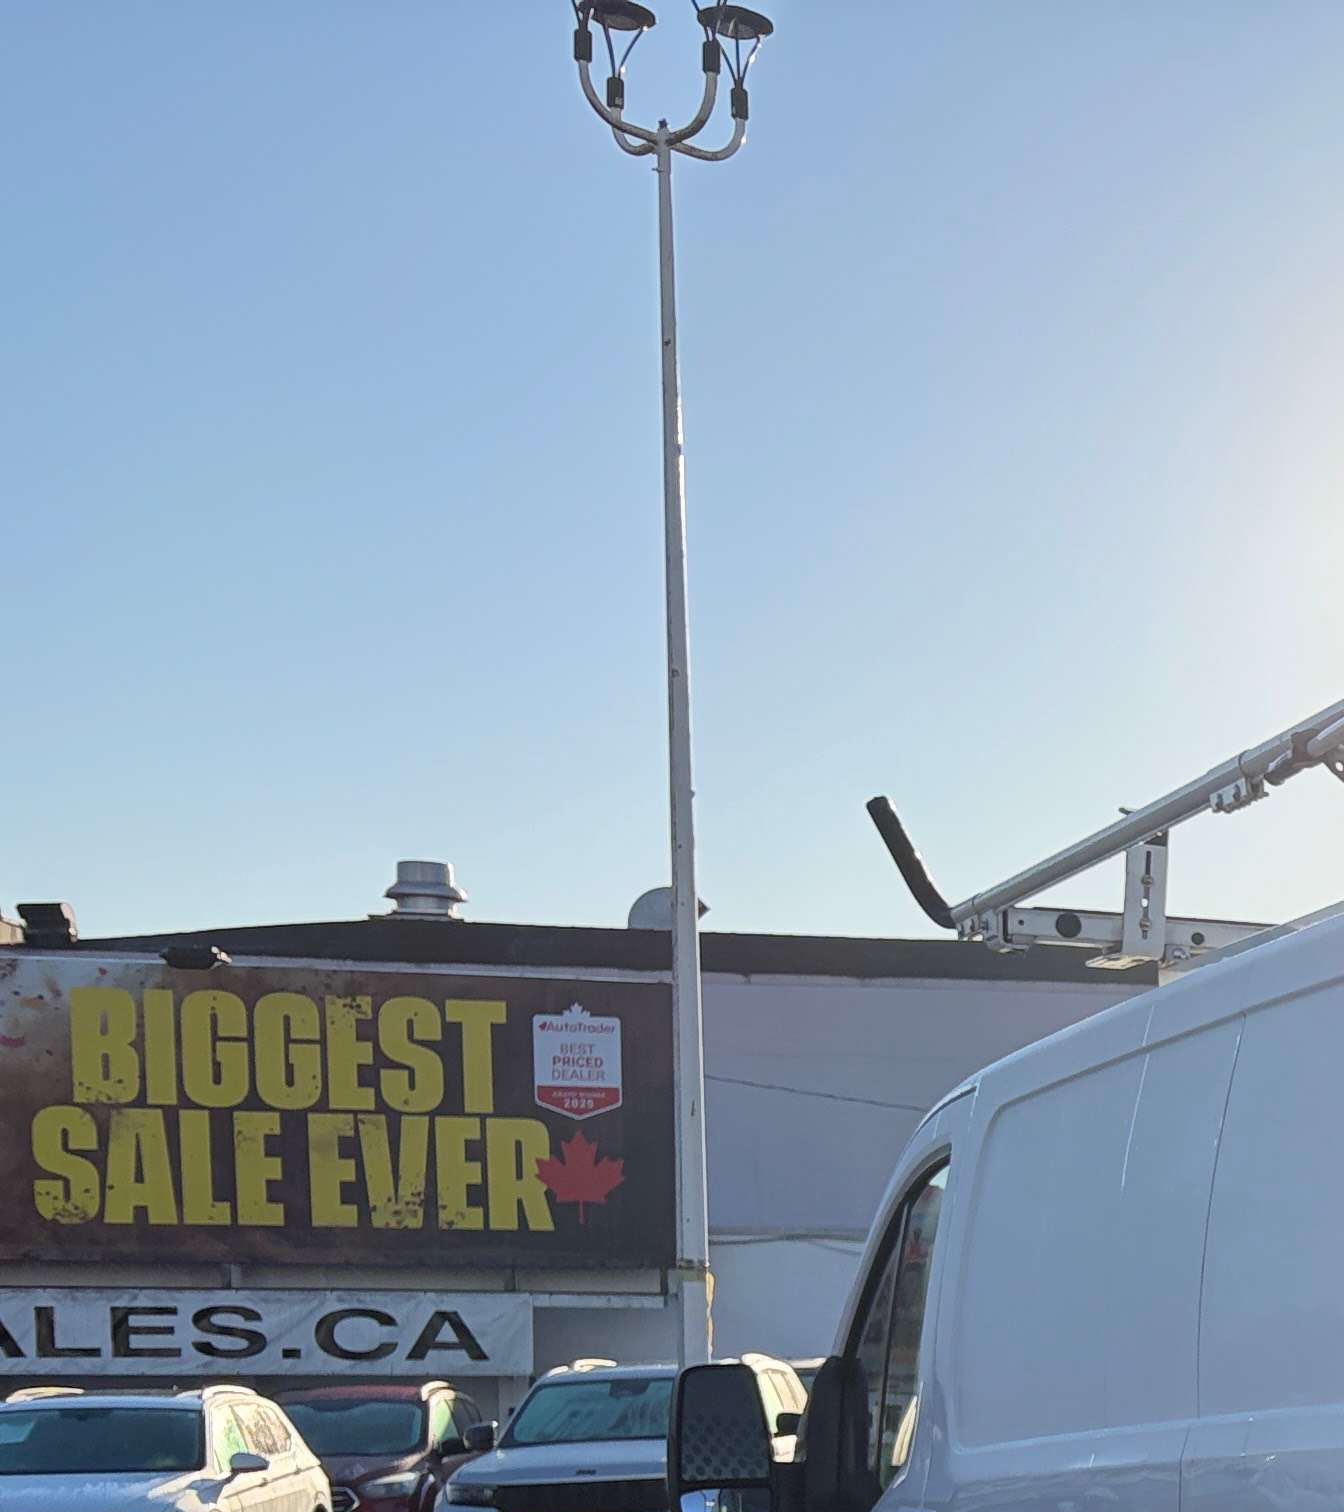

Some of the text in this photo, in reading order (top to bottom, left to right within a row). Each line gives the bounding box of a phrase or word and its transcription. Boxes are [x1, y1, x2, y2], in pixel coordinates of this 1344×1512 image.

[546, 1021, 616, 1034] AutoTrader
[70, 987, 508, 1114] BIGGEST
[560, 1043, 595, 1055] BEST
[552, 1055, 604, 1068] PRICED
[552, 1068, 605, 1081] DEALER
[31, 1106, 556, 1232] SALE EVER
